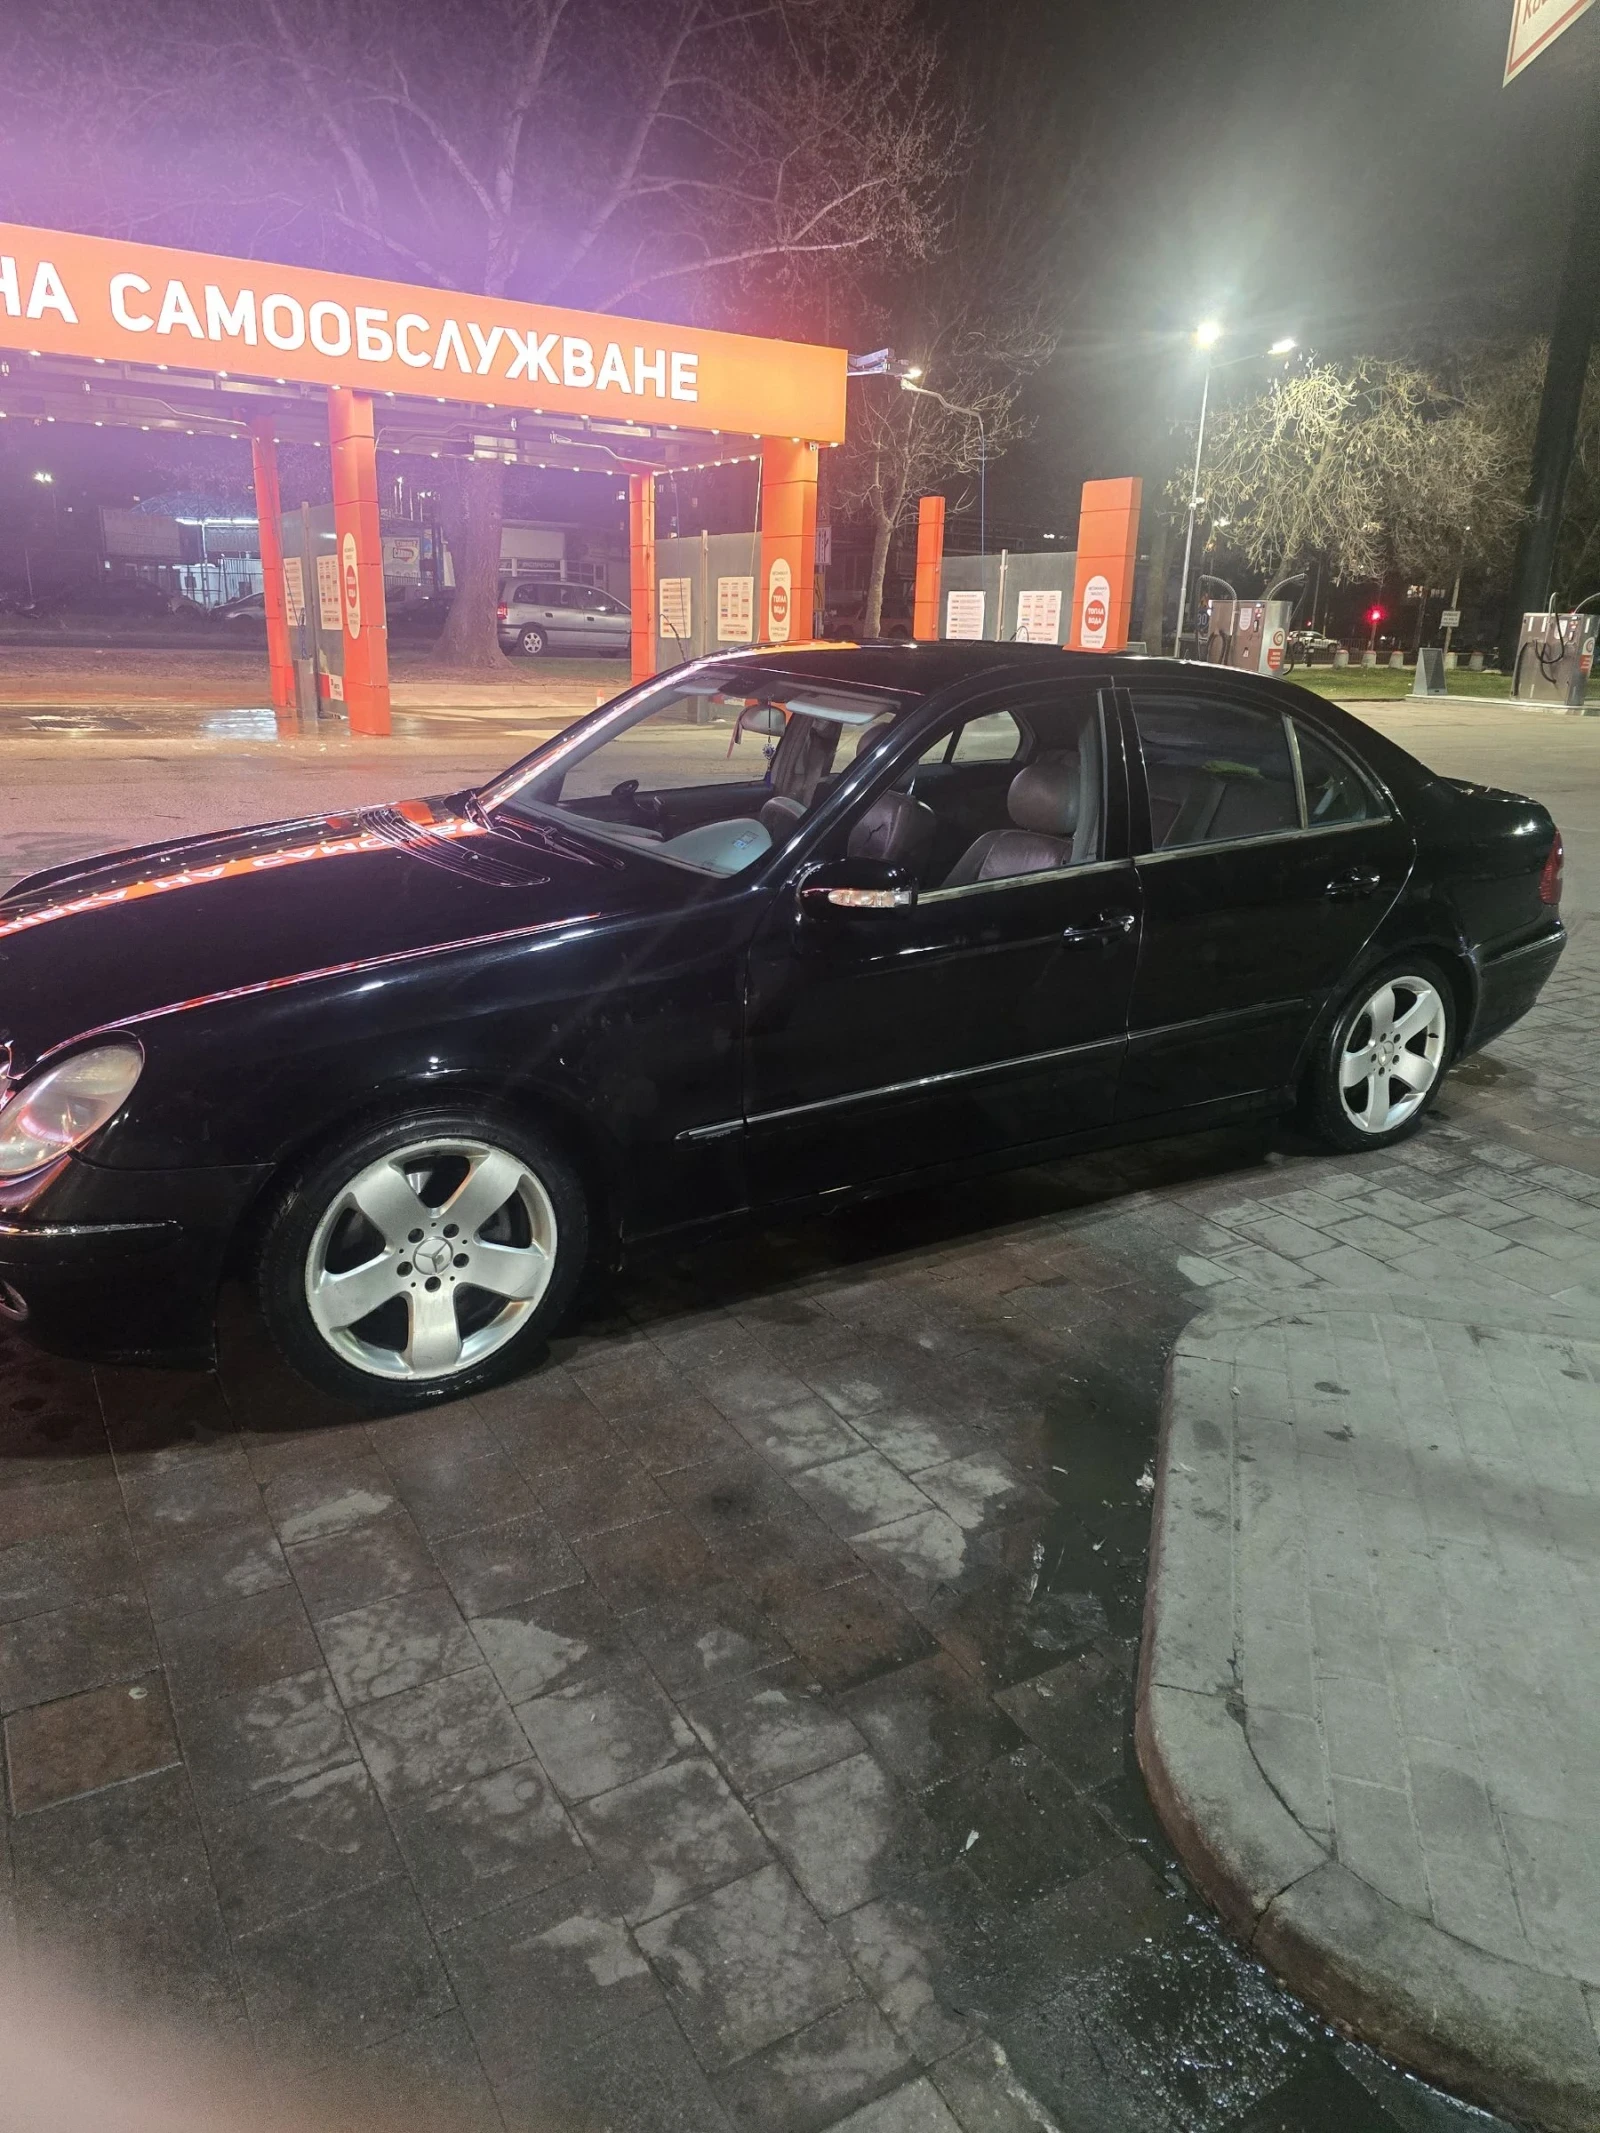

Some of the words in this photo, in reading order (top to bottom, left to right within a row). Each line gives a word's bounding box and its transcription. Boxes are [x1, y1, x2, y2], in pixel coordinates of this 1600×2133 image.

[110, 271, 700, 404] САМООБСЛУЖВАНЕ
[1088, 607, 1104, 615] ТОПЛА
[1088, 617, 1102, 625] ВОДА
